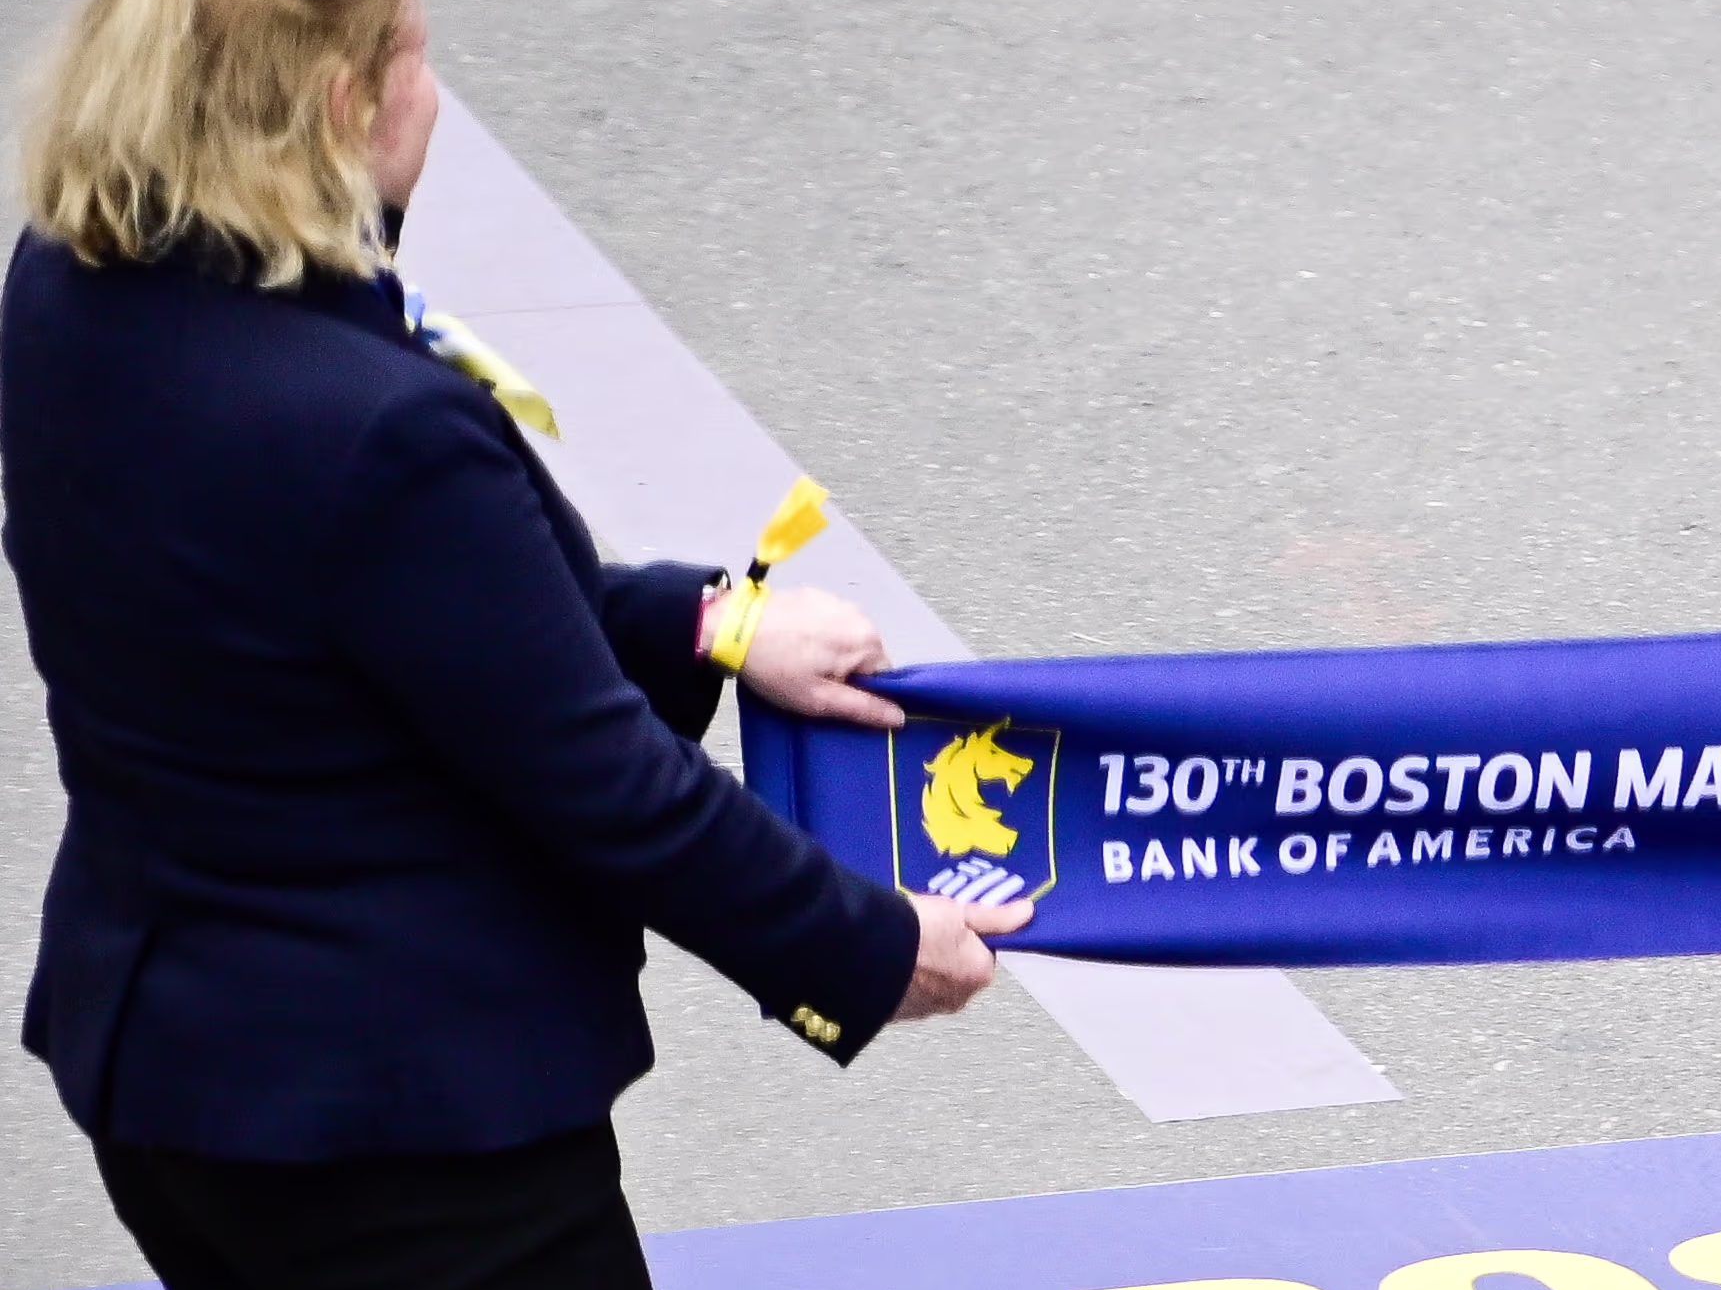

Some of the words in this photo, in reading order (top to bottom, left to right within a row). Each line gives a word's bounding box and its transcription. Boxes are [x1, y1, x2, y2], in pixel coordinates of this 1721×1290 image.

[1276, 751, 1591, 813] BOSTON
[1103, 837, 1261, 883] BANK
[1279, 834, 1351, 874] OF
[1367, 828, 1634, 867] AMERICA
